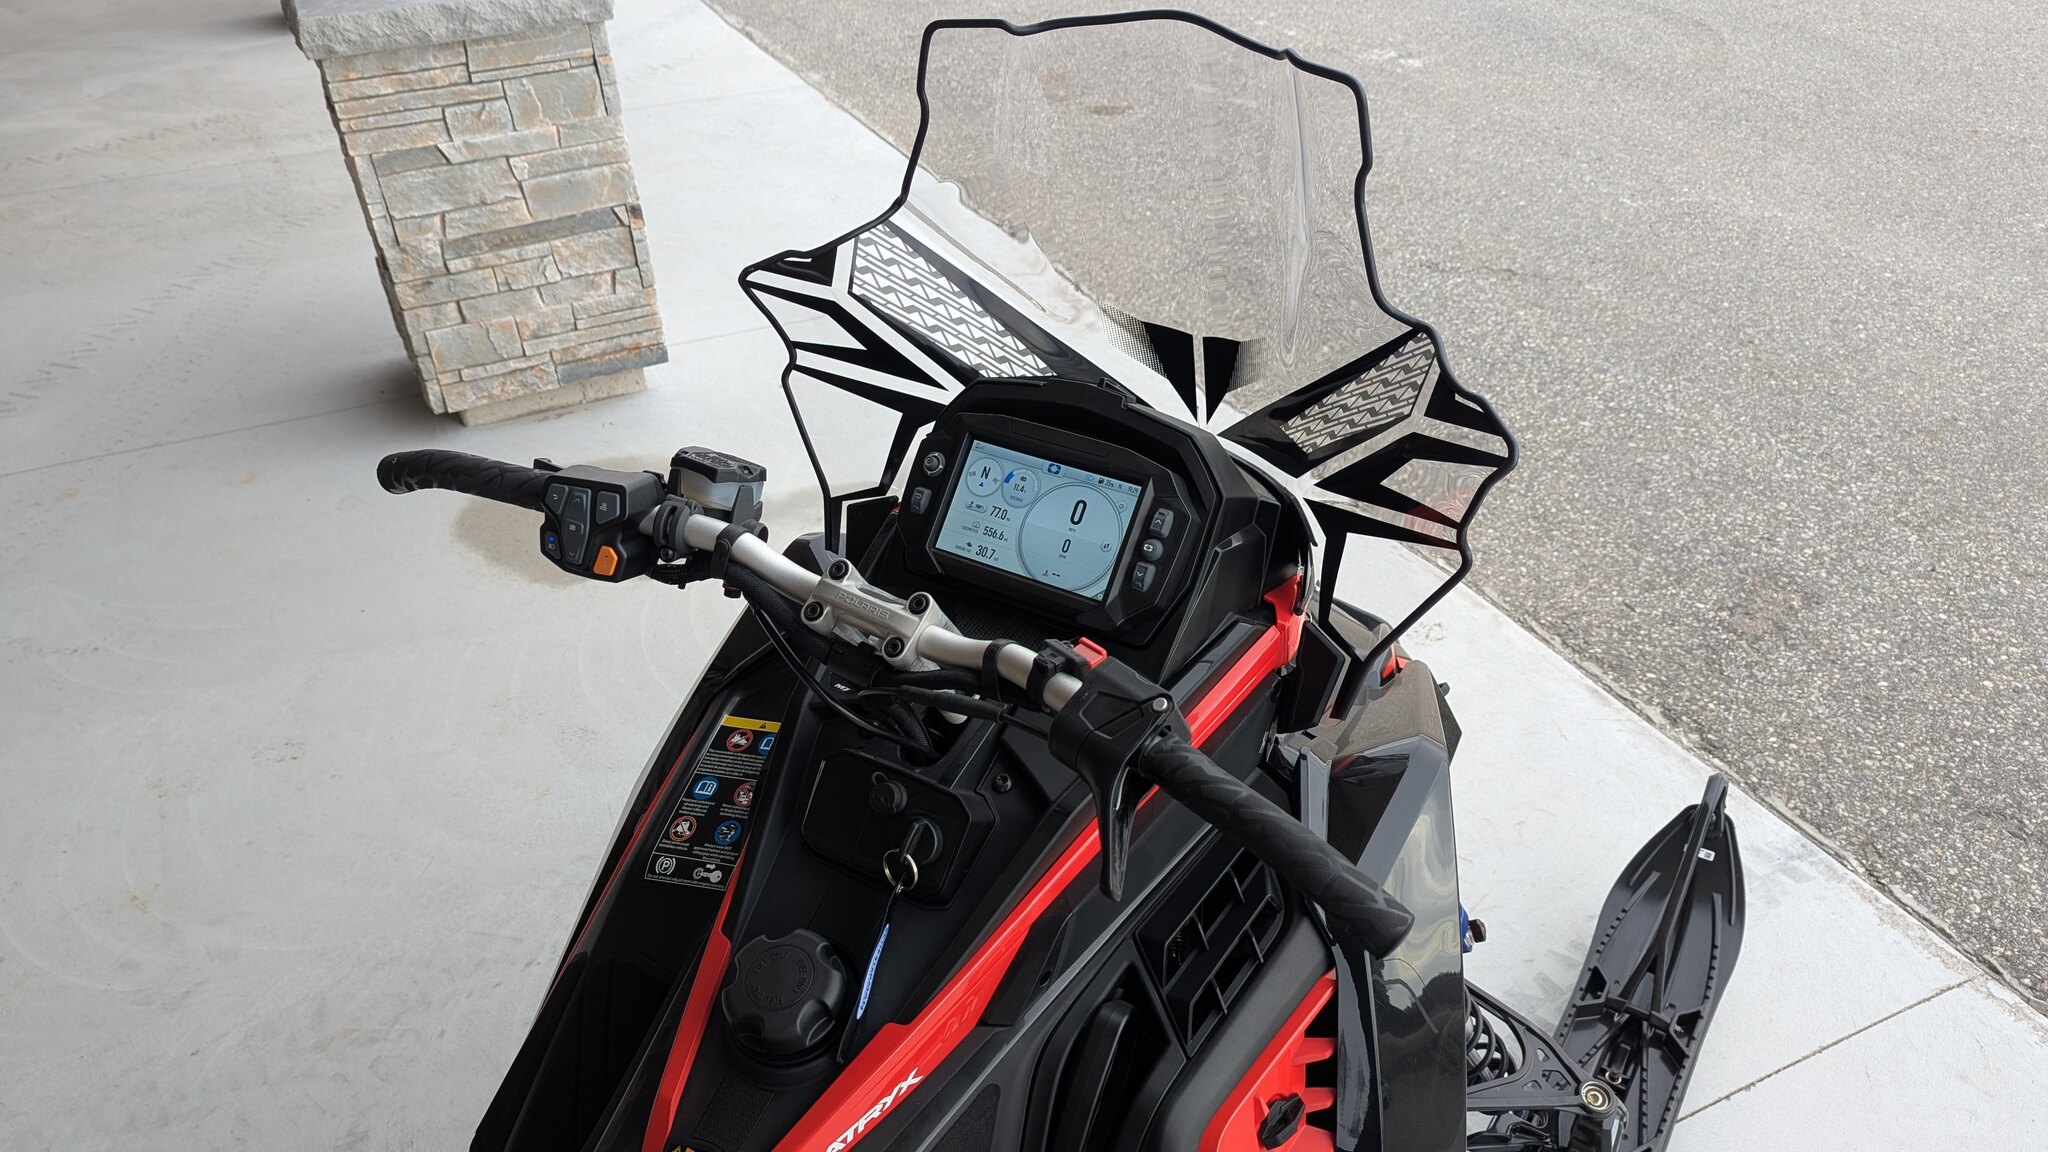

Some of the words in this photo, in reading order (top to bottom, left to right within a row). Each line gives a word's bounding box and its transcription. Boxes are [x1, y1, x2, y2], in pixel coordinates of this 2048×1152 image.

[980, 465, 991, 480] N
[989, 505, 1008, 521] 77.0
[1070, 499, 1087, 526] 0
[982, 525, 1005, 541] 556.6
[975, 544, 997, 560] 30.7
[1061, 538, 1071, 554] 0
[836, 590, 891, 619] POLARIS
